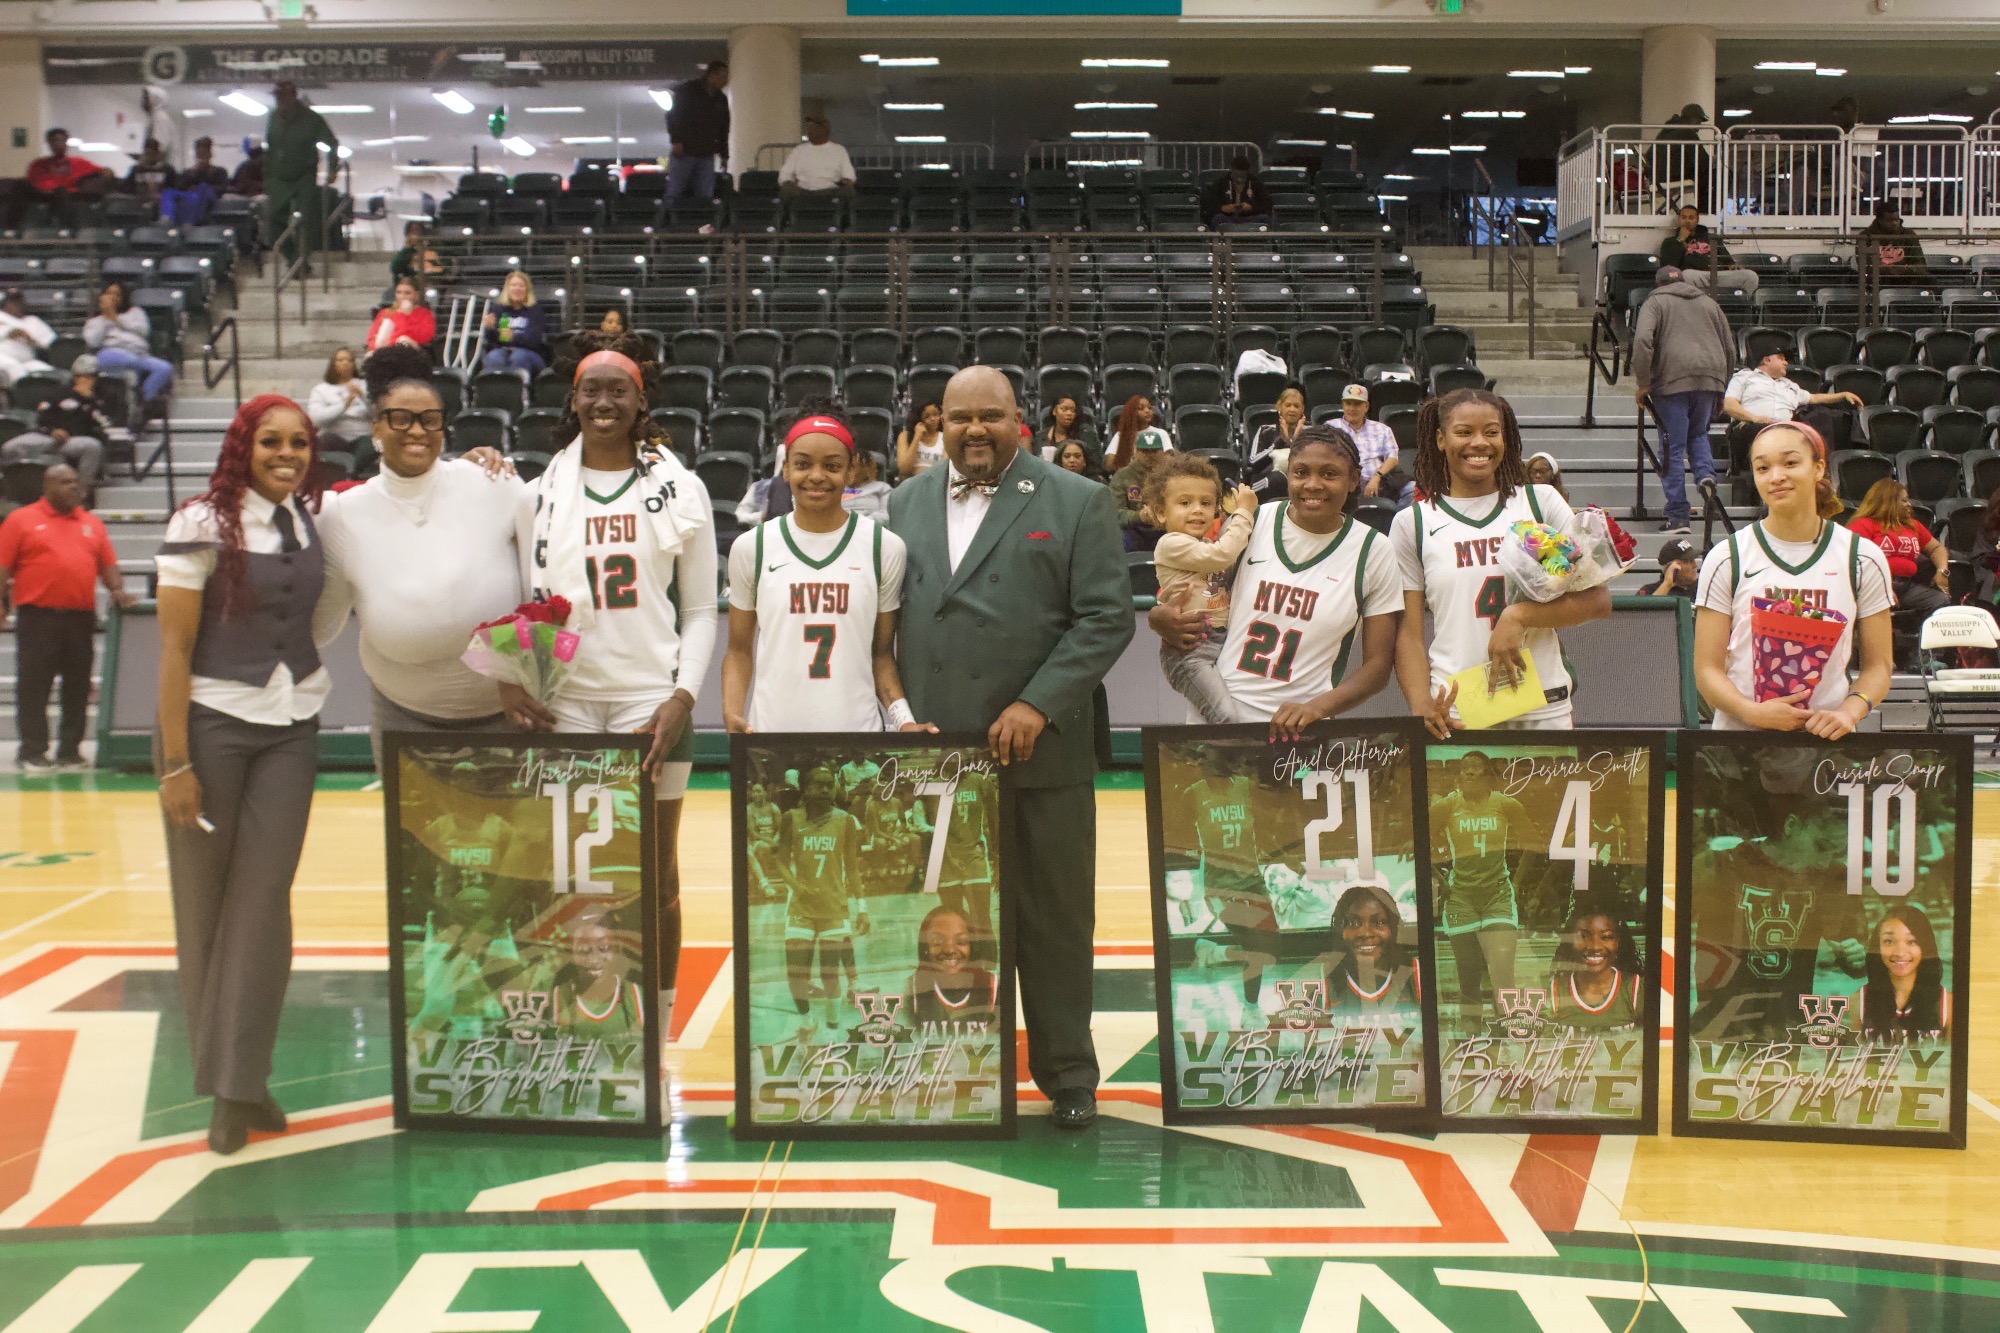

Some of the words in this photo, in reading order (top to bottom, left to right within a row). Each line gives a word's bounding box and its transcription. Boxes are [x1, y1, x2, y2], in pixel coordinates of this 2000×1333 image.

[262, 48, 388, 65] GATORADE
[585, 48, 622, 63] VALLEY
[624, 48, 655, 63] STATE
[1453, 536, 1505, 569] MVS
[789, 582, 850, 615] MVSU
[1253, 579, 1320, 622] MVSU
[1474, 575, 1508, 632] 4
[803, 623, 836, 680] 7
[1236, 620, 1303, 683] 21
[877, 757, 939, 800] Janiya
[1273, 744, 1324, 787] Ariel
[1325, 739, 1404, 784] Jefferson
[1502, 755, 1584, 797] Desiree
[1586, 746, 1651, 792] Smith
[956, 790, 977, 803] VSU
[1210, 804, 1245, 824] MVSU
[543, 783, 614, 894] 12
[802, 835, 837, 851] MVSU
[914, 782, 957, 893] 7
[1221, 823, 1242, 850] 21
[1302, 768, 1376, 882] 21
[1459, 816, 1498, 834] MVSU
[1473, 834, 1487, 858] 4
[1548, 780, 1597, 891] 4
[1838, 783, 1917, 896] 10
[450, 847, 492, 865] MVSU
[813, 854, 826, 879] 7
[797, 1038, 957, 1123] Basketball
[1180, 1062, 1422, 1108] STATE
[1221, 1026, 1378, 1108] Basketball
[1440, 1034, 1599, 1115] Basketball
[1736, 1040, 1906, 1121] Basketball
[754, 1080, 997, 1123] STATE
[1690, 1077, 1946, 1129] STATE
